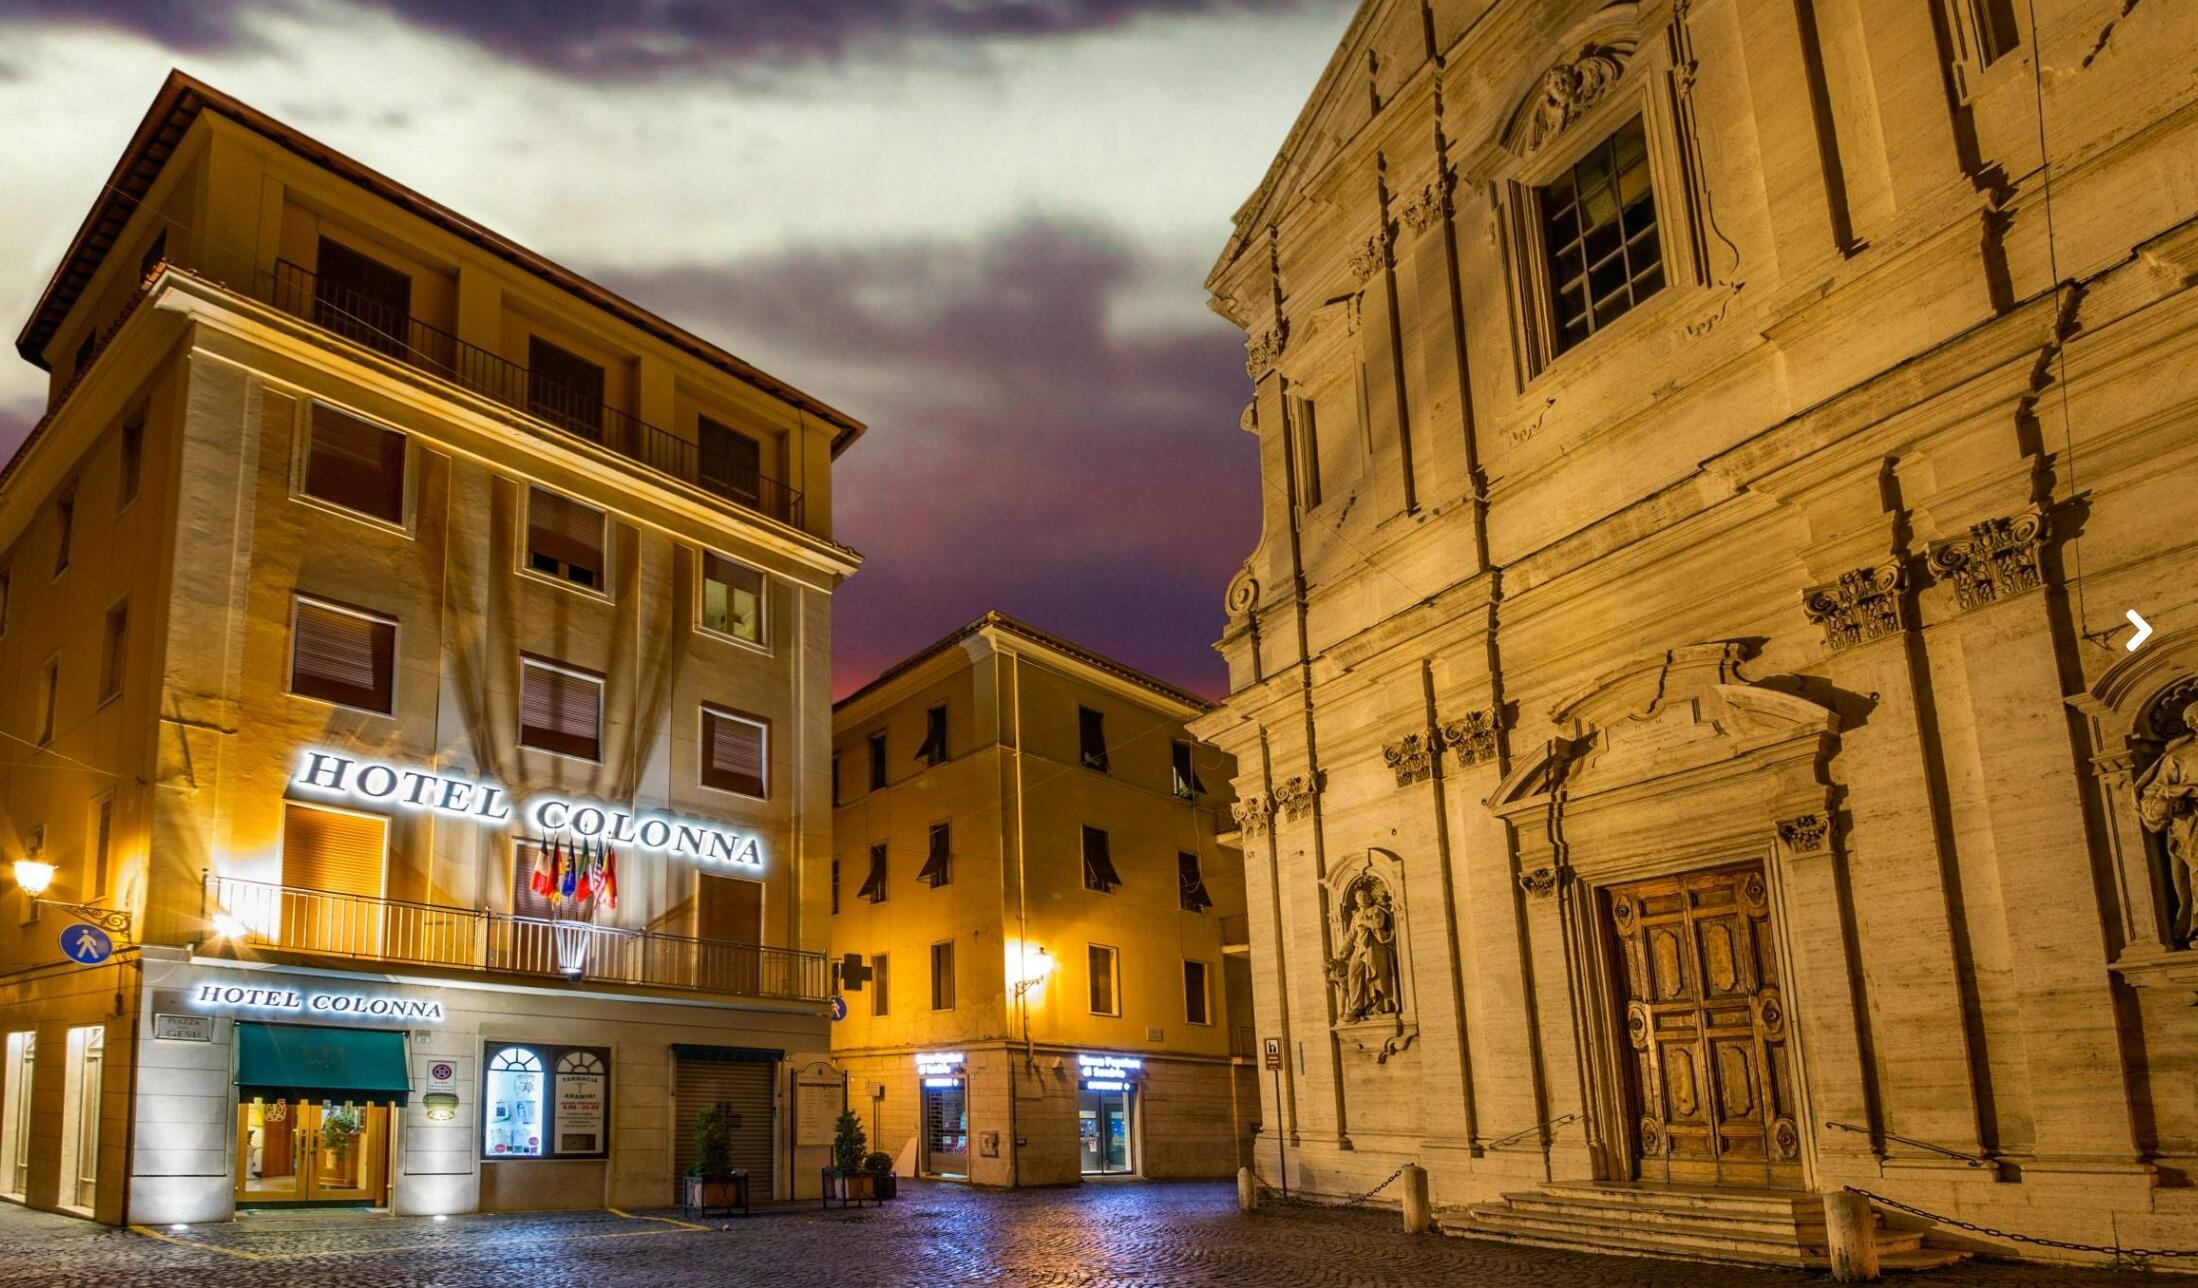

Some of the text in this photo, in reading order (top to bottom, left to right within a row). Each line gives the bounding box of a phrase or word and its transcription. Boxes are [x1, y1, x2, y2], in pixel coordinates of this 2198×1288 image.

[299, 752, 762, 865] HOTEL COLONNA
[200, 986, 442, 1017] HOTEL COLONNA
